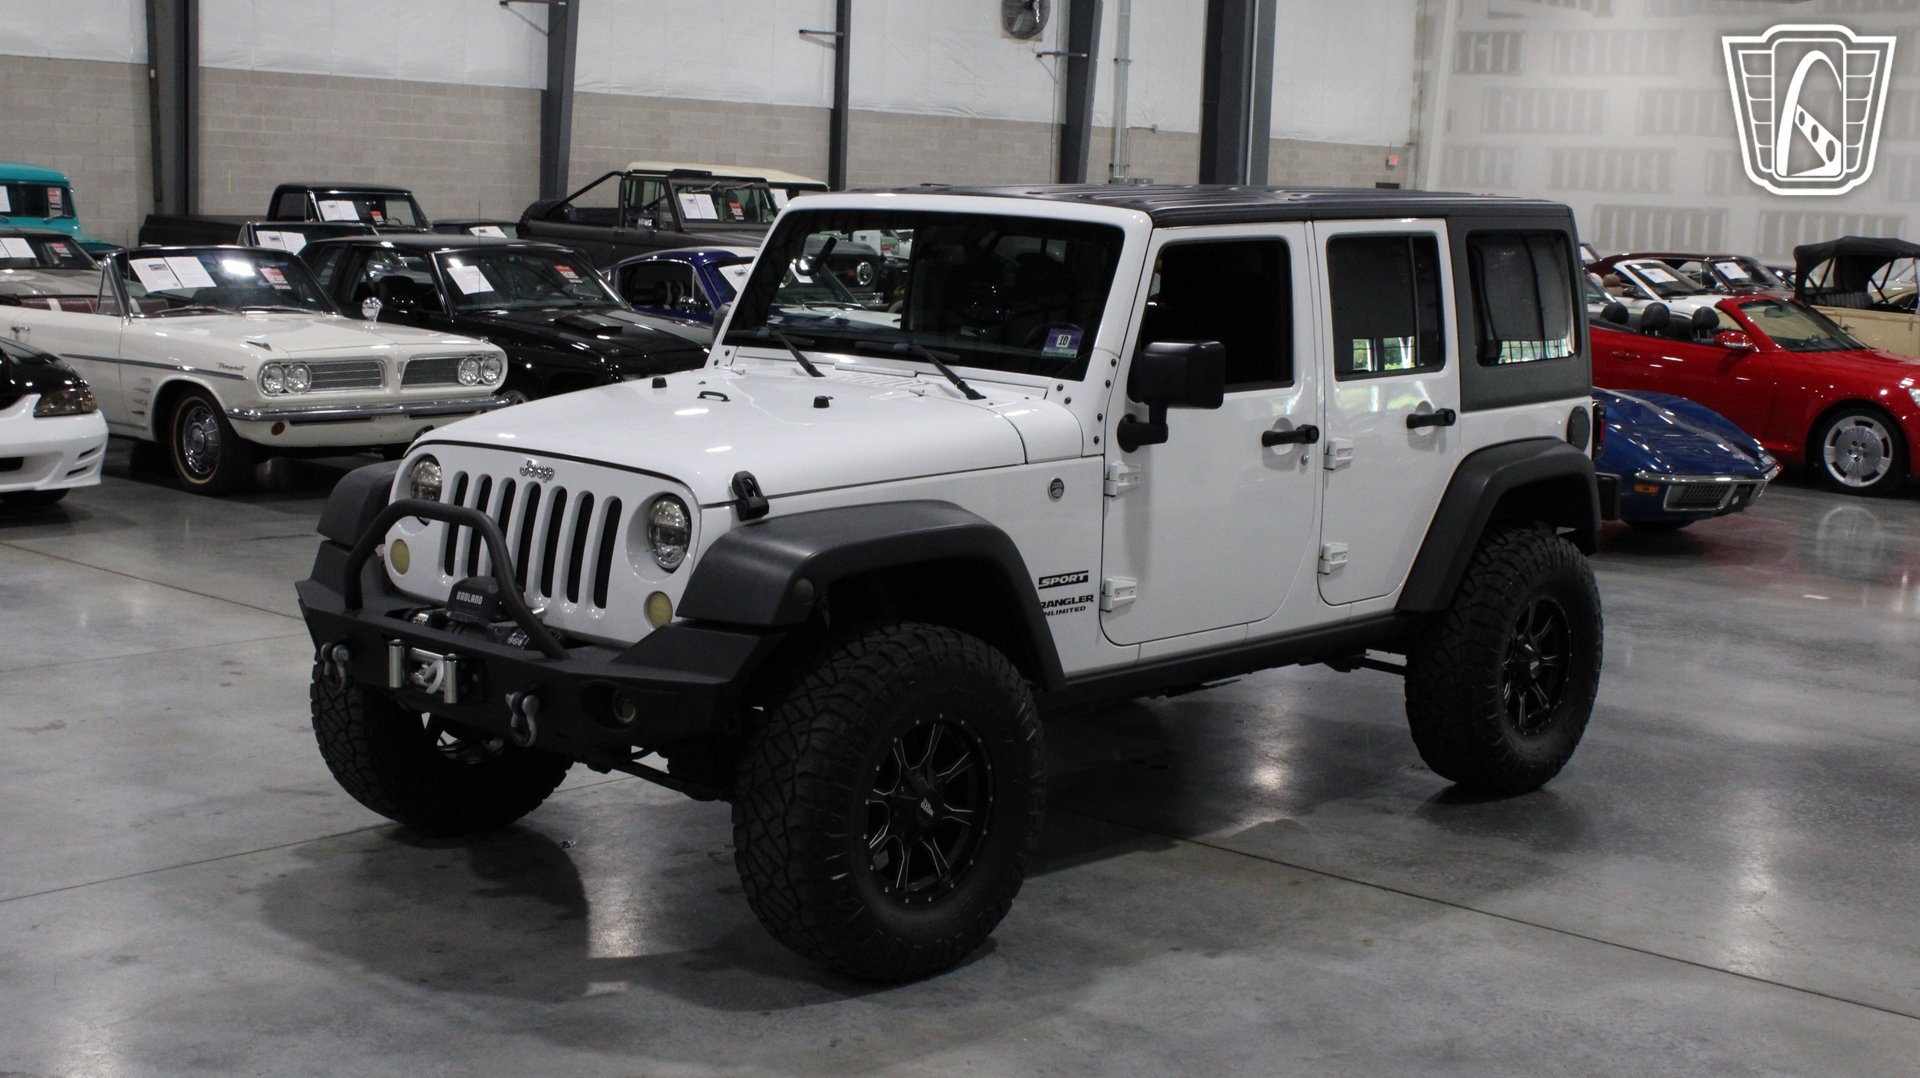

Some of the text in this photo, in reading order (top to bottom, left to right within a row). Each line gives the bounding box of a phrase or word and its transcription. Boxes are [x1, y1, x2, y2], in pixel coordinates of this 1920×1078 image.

[1059, 335, 1069, 346] 10
[520, 459, 555, 483] Jeep
[1039, 573, 1088, 587] SPORT
[1040, 594, 1094, 608] RANGLER
[1043, 606, 1086, 616] NLIMITED
